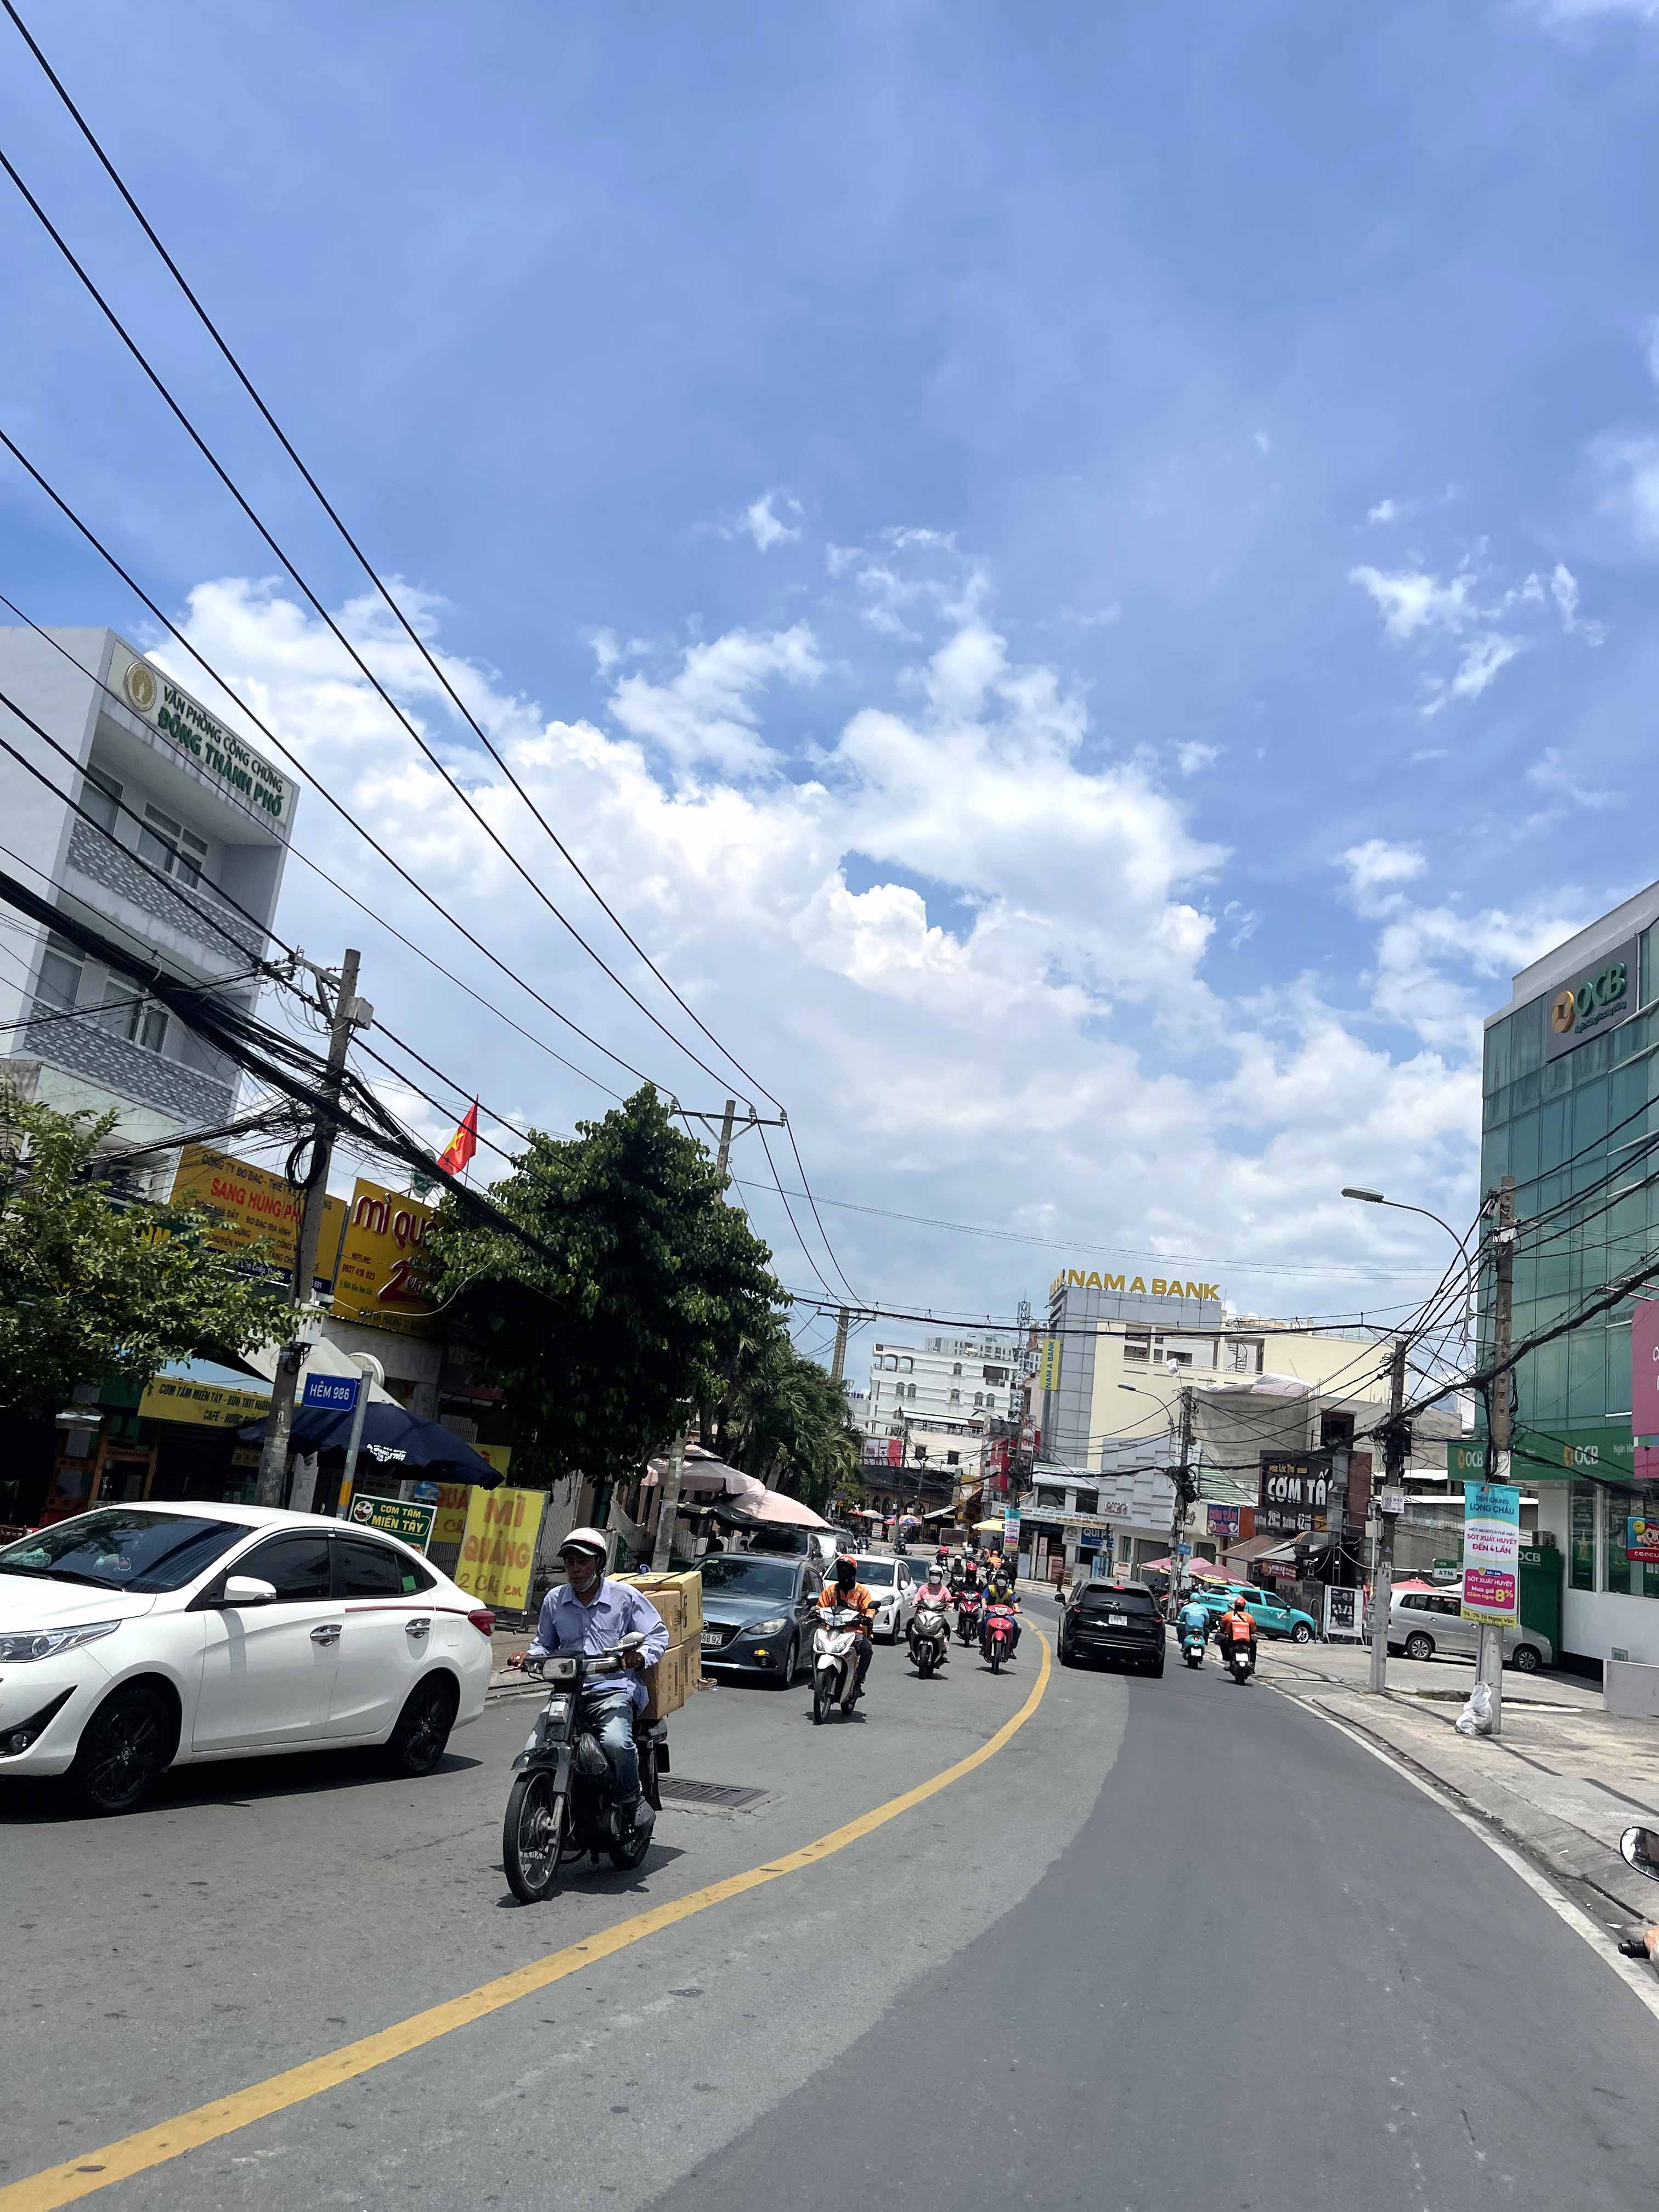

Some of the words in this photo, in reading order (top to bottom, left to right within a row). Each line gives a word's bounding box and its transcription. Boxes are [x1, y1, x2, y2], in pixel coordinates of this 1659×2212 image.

[164, 685, 185, 714] VĂN
[186, 706, 222, 744] PHÒNG
[223, 737, 250, 766] CÔNG
[251, 759, 283, 793] CHỨNG
[205, 742, 253, 796] THÀNH
[253, 781, 285, 817] PHỐ
[1573, 963, 1626, 1017] OCB
[210, 1177, 246, 1206] SANG
[247, 1190, 282, 1219] HÙNG
[1068, 1269, 1125, 1291] NAM
[1129, 1277, 1147, 1294] A
[1152, 1278, 1221, 1300] BANK
[309, 1380, 331, 1398] HẺM
[332, 1387, 351, 1401] 986
[1045, 1372, 1053, 1389] NAM
[1465, 1451, 1483, 1468] OCB
[1574, 1445, 1599, 1466] OCB
[1267, 1476, 1302, 1504] CƠM
[1306, 1468, 1334, 1506] TẤ
[380, 1504, 400, 1515] CƠM
[483, 1493, 526, 1528] MÌ
[1470, 1503, 1492, 1512] LONG
[1493, 1505, 1515, 1515] CHÂU
[371, 1514, 399, 1529] MIỀN
[403, 1519, 425, 1533] TÂY
[464, 1529, 531, 1569] QUẢNG
[1472, 1541, 1489, 1551] ĐẾN
[1438, 1570, 1454, 1578] ATM
[457, 1573, 470, 1589] 2
[504, 1584, 523, 1597] em
[1495, 1589, 1514, 1602] 8%
[701, 1634, 721, 1645] 88.92
